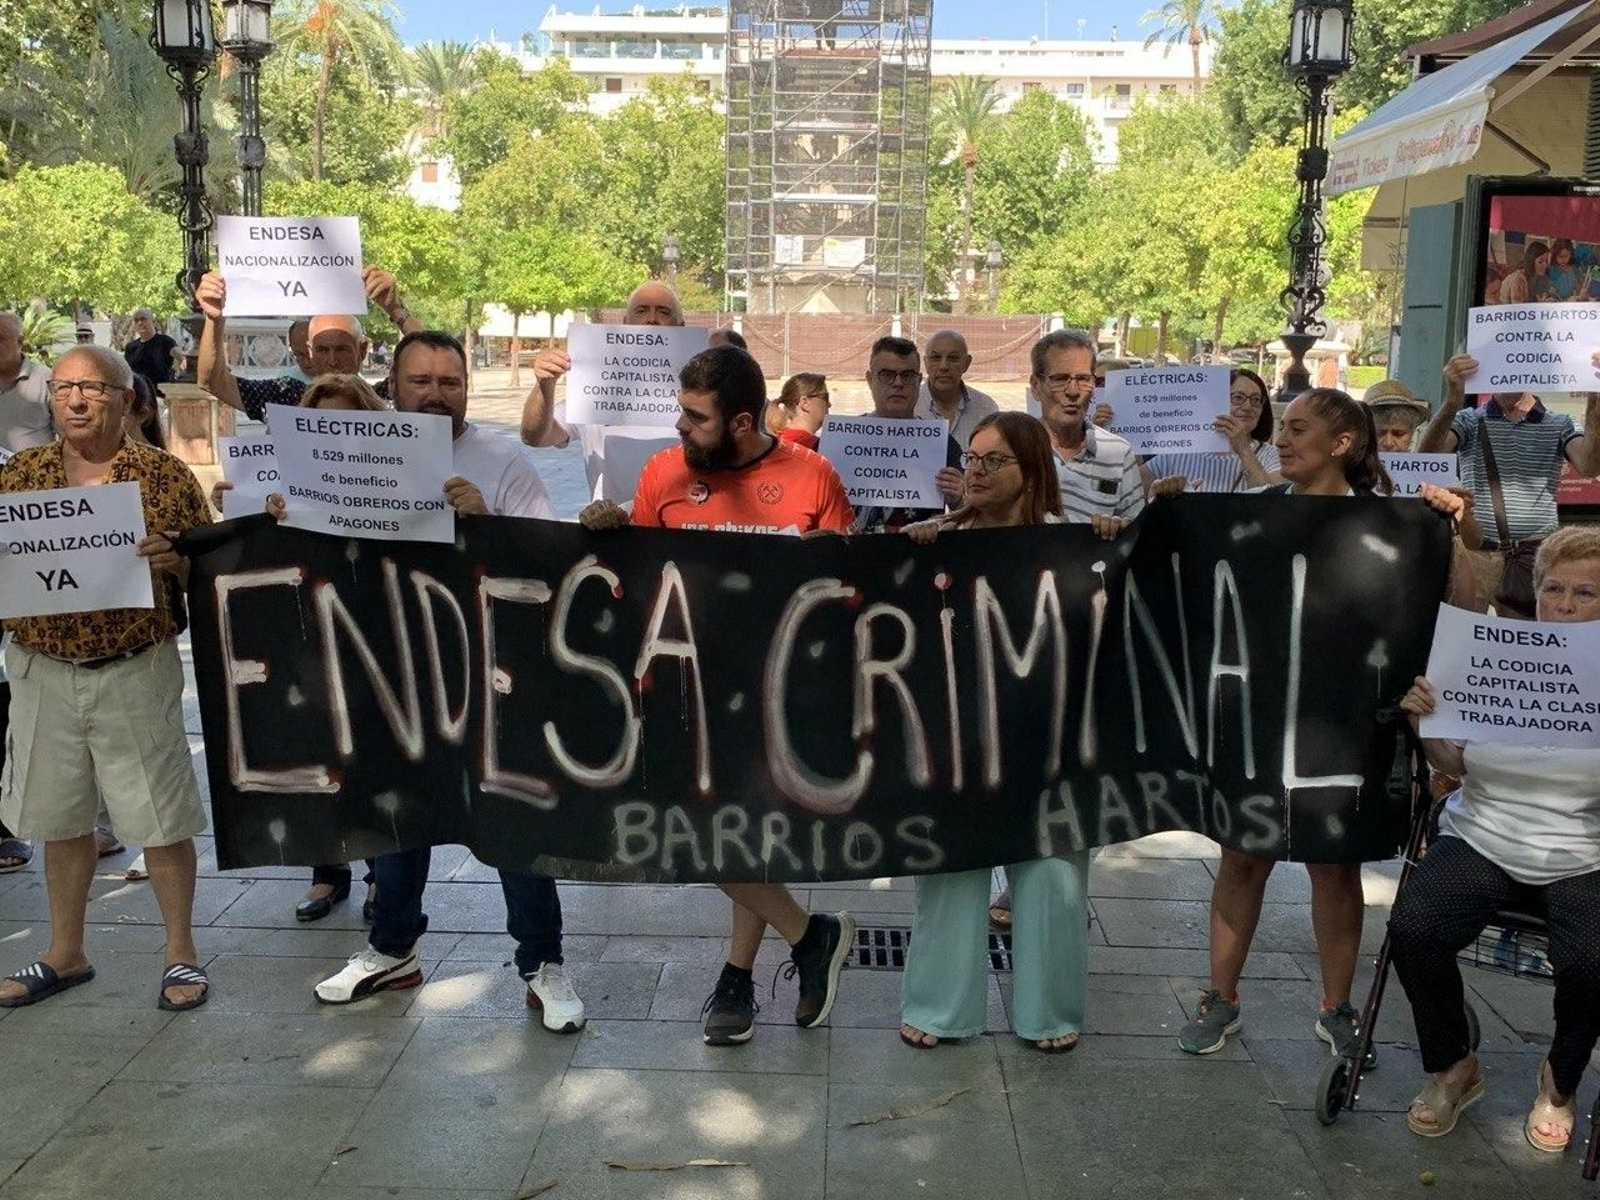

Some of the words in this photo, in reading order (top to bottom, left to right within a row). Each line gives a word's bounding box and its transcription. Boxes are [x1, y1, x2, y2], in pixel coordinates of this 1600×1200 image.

[249, 226, 325, 241] ENDESA
[277, 280, 308, 297] YA
[1475, 310, 1536, 324] BARRIOS
[1540, 309, 1598, 321] HARTOS
[606, 333, 668, 346] ENDESA:
[1495, 331, 1552, 343] CONTRA
[1557, 332, 1575, 342] LA
[604, 356, 619, 366] LA
[623, 357, 671, 368] CODICIA
[1506, 353, 1562, 364] CODICIA
[601, 370, 675, 383] CAPITALISTA
[1125, 372, 1208, 386] ELÉCTRICAS:
[1490, 374, 1578, 386] CAPITALISTA
[583, 386, 632, 397] CONTRA
[635, 388, 650, 397] LA
[653, 388, 681, 398] CLA
[1160, 393, 1198, 402] millones
[594, 401, 681, 413] TRABAJADORA
[1139, 411, 1151, 419] de
[1153, 410, 1193, 419] beneficio
[295, 417, 419, 438] ELÉCTRICAS:
[828, 421, 883, 436] BARRIOS
[887, 426, 941, 437] HARTOS
[1110, 425, 1152, 434] BARRIOS
[1154, 424, 1201, 433] OBREROS
[1203, 424, 1218, 432] CO
[229, 444, 275, 458] BARR
[1140, 439, 1193, 449] APAGONES
[312, 449, 345, 462] 8.529
[348, 453, 404, 466] millones
[844, 445, 899, 458] CONTRA
[903, 448, 919, 459] LA
[854, 467, 908, 479] CODICIA
[1391, 461, 1449, 473] HARTOS
[321, 472, 336, 483] de
[339, 473, 398, 488] beneficio
[289, 485, 340, 505] BARRIOS
[343, 496, 410, 511] OBREROS
[414, 500, 445, 511] CON
[0, 498, 94, 523] ENDESA
[329, 514, 400, 532] APAGONES
[9, 530, 136, 555] ONALIZACIÓN
[36, 568, 79, 591] YA
[1474, 624, 1567, 648] ENDESA:
[1471, 656, 1493, 669] LA
[1498, 659, 1573, 676] CODICIA
[213, 555, 712, 810] ENDESA
[1467, 674, 1580, 695] CAPITALISTA
[1443, 690, 1514, 709] CONTRA
[1519, 698, 1542, 711] LA
[1547, 700, 1600, 715] CLAS
[1459, 709, 1593, 733] TRABAJADORA
[613, 801, 945, 871] BARRIOS
[1038, 770, 1281, 857] HARTOS
